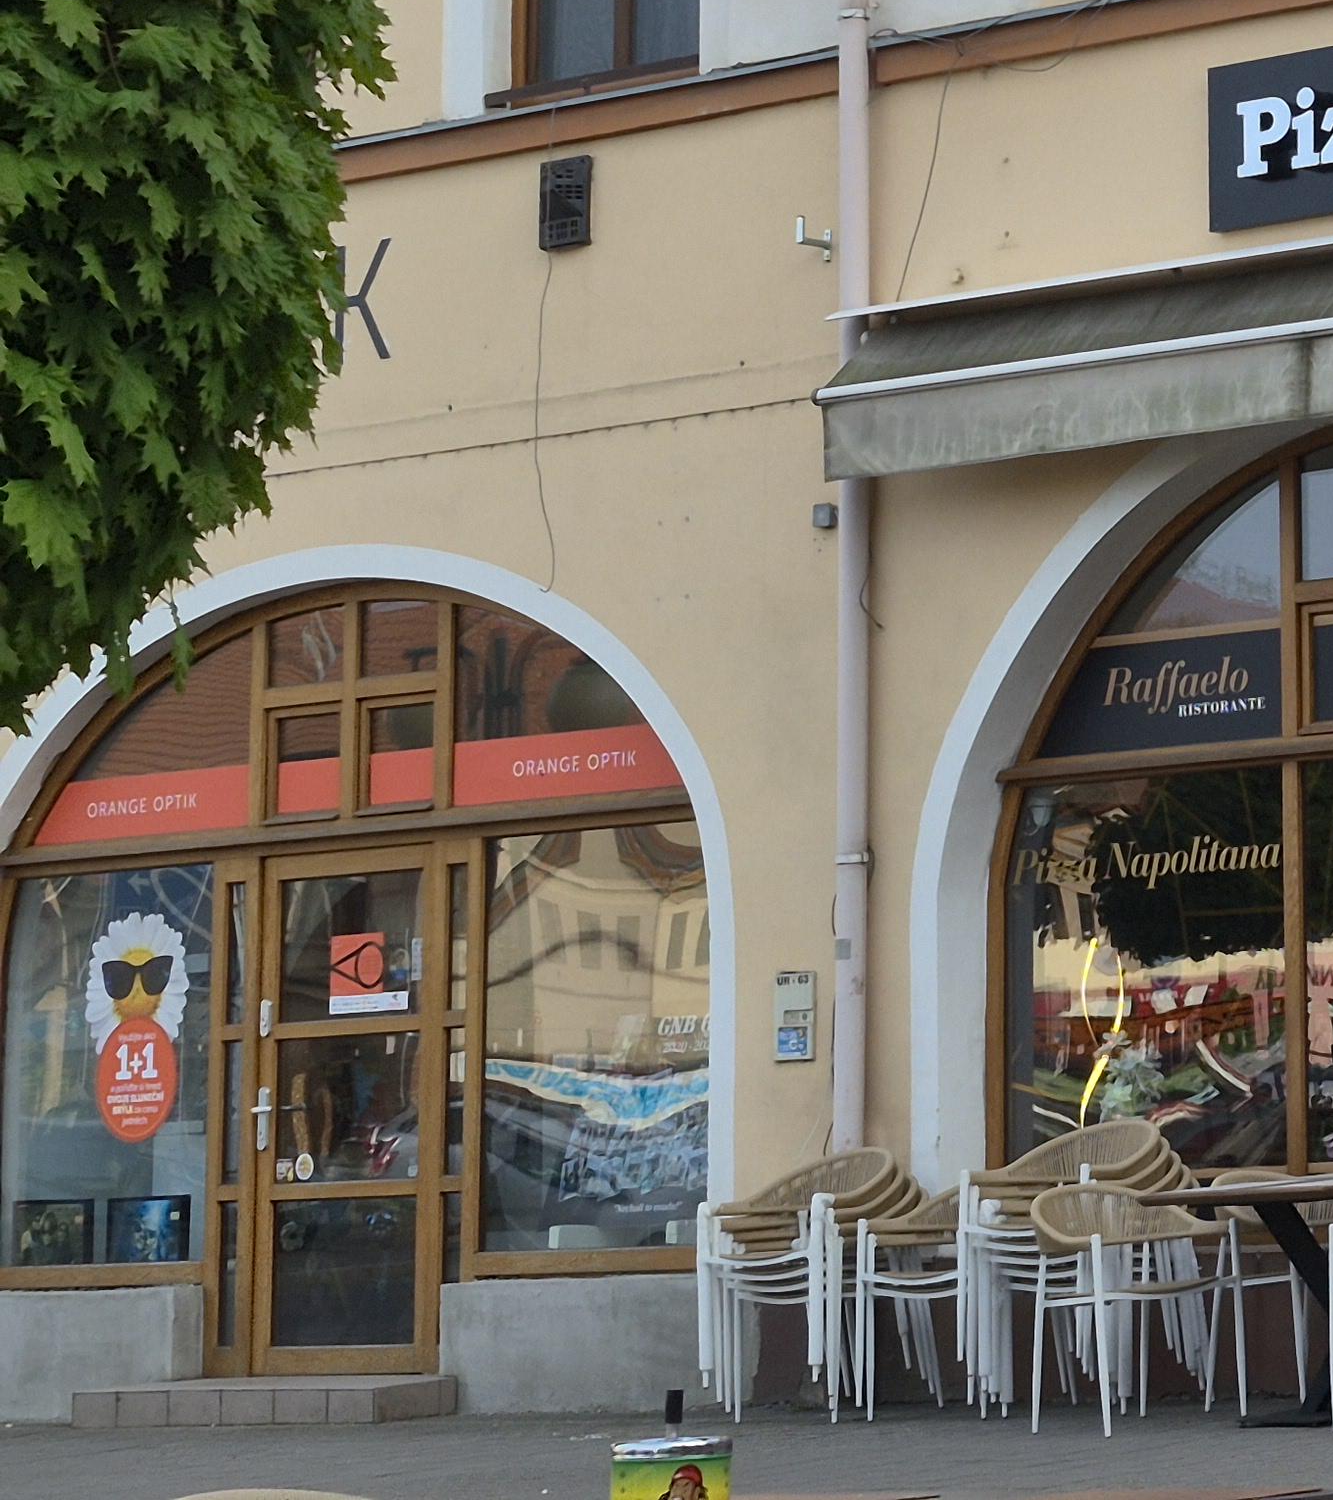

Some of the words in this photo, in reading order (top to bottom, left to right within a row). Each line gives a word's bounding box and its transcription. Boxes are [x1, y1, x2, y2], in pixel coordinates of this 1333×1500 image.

[1102, 656, 1249, 714] Raffaelo
[1178, 696, 1266, 717] RISTORANTE
[513, 755, 580, 777] ORANGE
[587, 750, 637, 771] OPTIK
[87, 797, 147, 818] ORANGE
[153, 793, 197, 812] OPTIK
[1012, 847, 1097, 885] Pizza
[1103, 834, 1281, 890] Napolitana
[658, 1015, 697, 1036] GNB
[115, 1042, 158, 1080] 1+1
